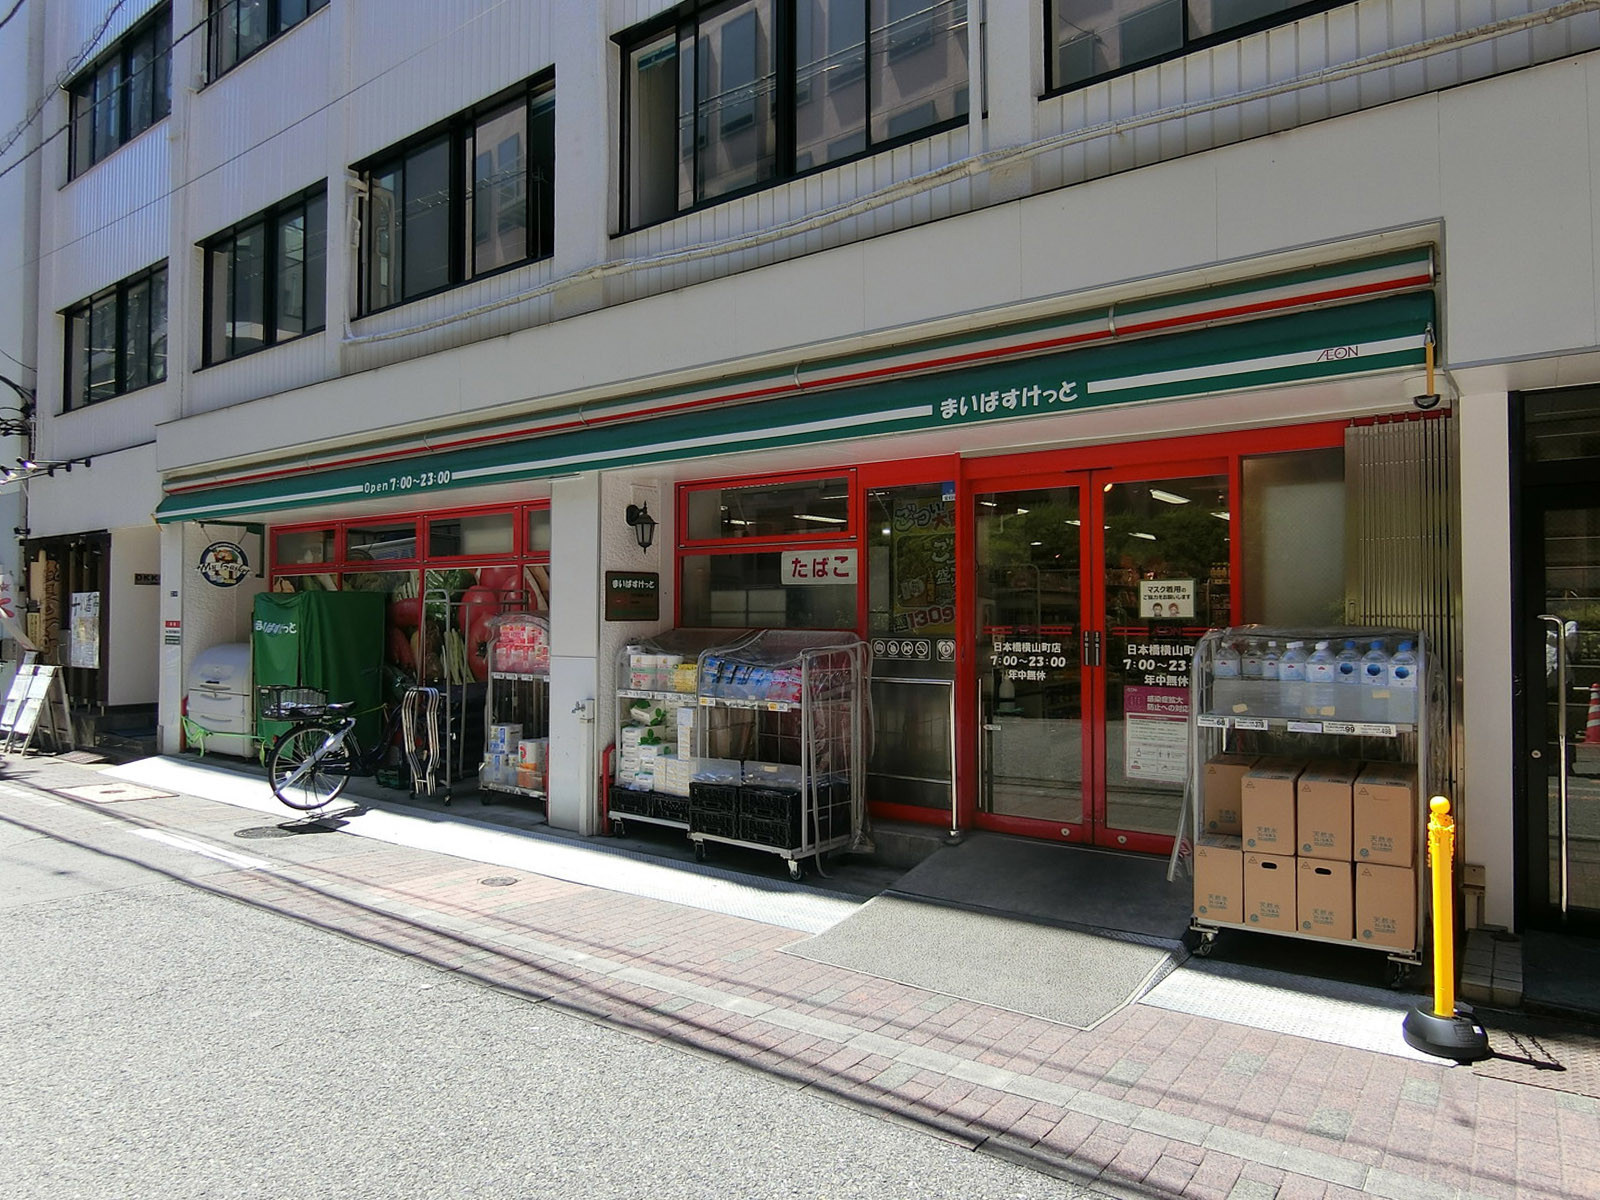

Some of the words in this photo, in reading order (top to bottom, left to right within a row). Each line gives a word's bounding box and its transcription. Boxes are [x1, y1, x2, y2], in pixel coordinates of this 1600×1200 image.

[940, 380, 1079, 420] まいばすけっと
[363, 482, 389, 494] Open
[791, 556, 850, 578] たばこ
[612, 579, 655, 589] まいばすけっと
[1147, 585, 1187, 594] マスク着用の
[993, 641, 1062, 654] 日本橋横山町店
[1008, 669, 1046, 681] 年中無休
[1143, 674, 1189, 687] 年中無休
[1147, 695, 1184, 704] 感染症拡大
